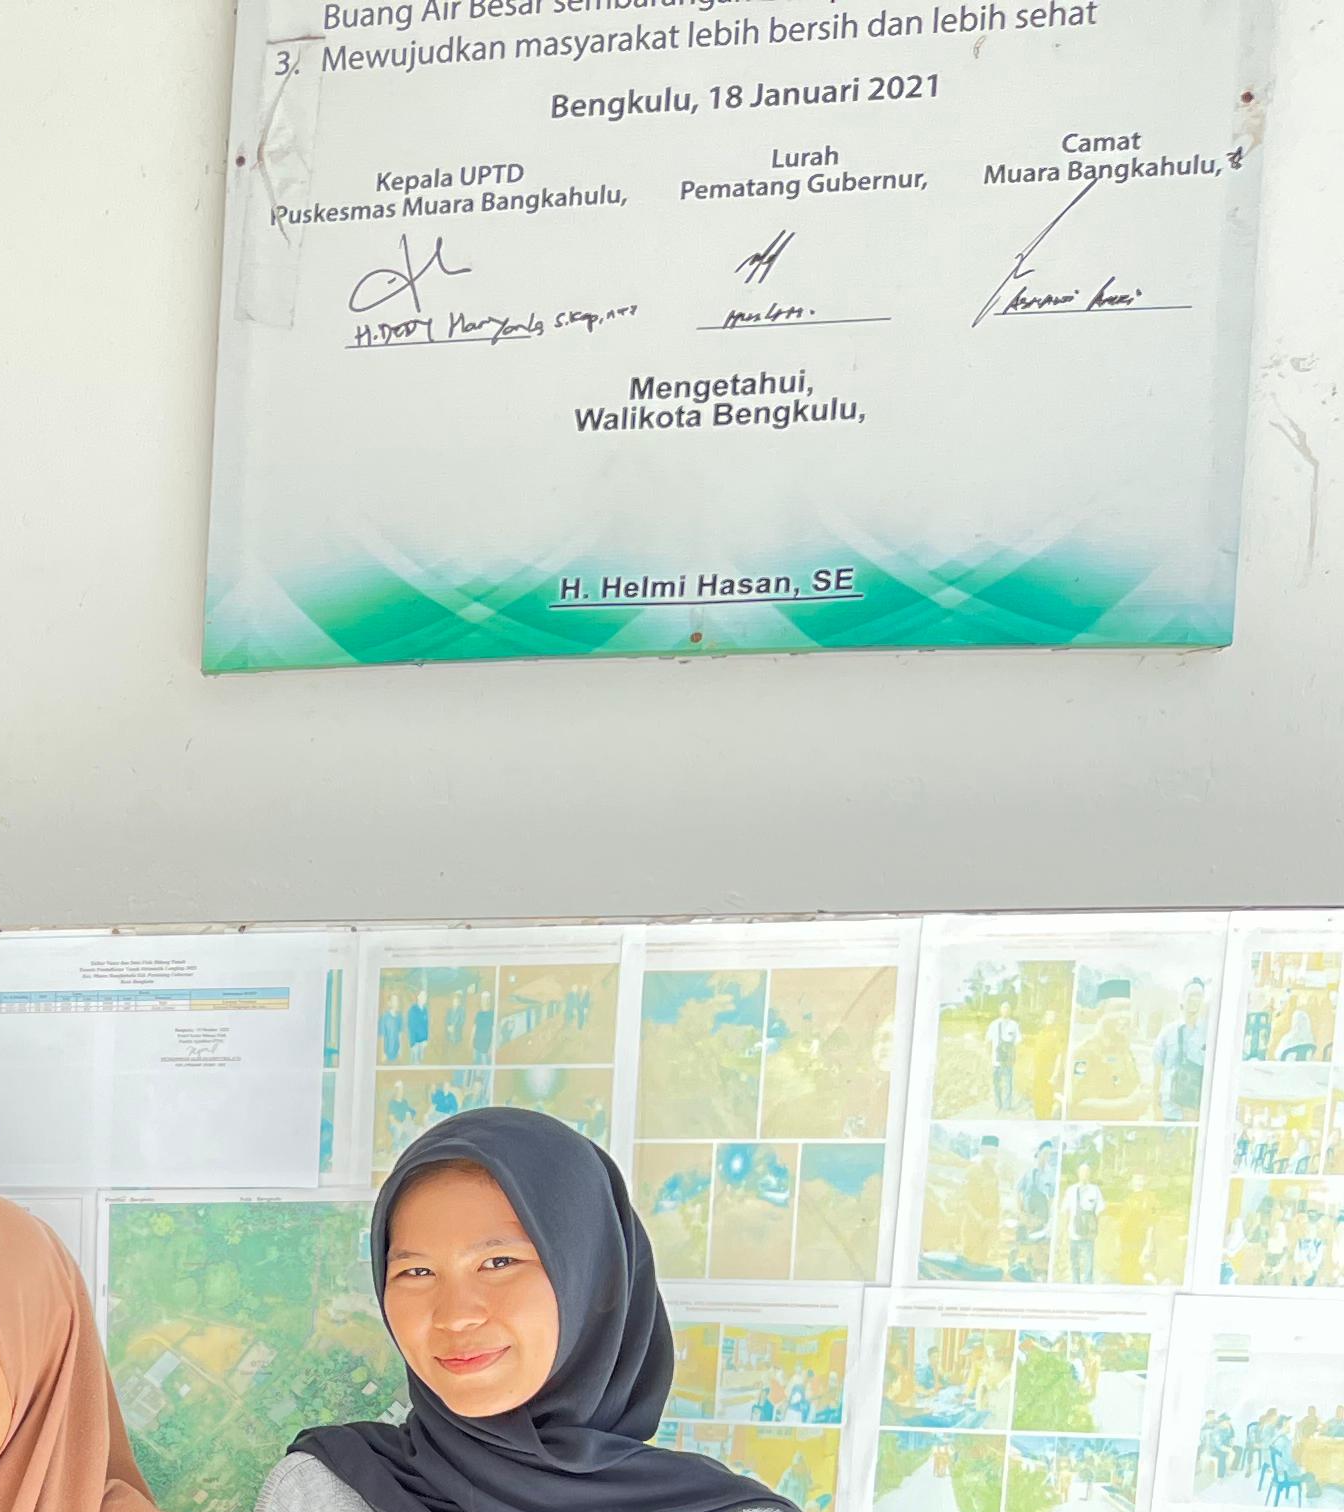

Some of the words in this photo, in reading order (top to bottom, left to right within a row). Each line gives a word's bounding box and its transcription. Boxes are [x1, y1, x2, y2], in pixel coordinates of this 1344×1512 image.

[324, 2, 412, 31] Buang
[421, 0, 461, 22] Air
[470, 0, 543, 19] Besar
[275, 51, 301, 76] 3.
[322, 36, 506, 73] Mewujudkan
[515, 24, 680, 62] masyarakat
[689, 19, 760, 49] lebih
[769, 12, 859, 45] bersih
[867, 7, 925, 38] dan
[931, 3, 1007, 35] lebih
[1015, 0, 1098, 29] sehat
[551, 86, 700, 121] Bengkulu,
[710, 84, 743, 111] 18
[749, 78, 860, 110] Januari
[867, 72, 942, 101] 2021
[771, 145, 839, 170] Lurah
[1061, 130, 1142, 155] Camat
[376, 167, 453, 195] Kepala
[460, 163, 525, 187] UPTD
[680, 174, 801, 203] Pematang
[807, 167, 928, 196] Gubernur,
[983, 160, 1061, 187] Muara
[1066, 153, 1223, 185] Bangkahulu,
[271, 200, 396, 227] Puskesmas
[402, 197, 474, 217] Muara
[480, 184, 628, 216] Bangkahulu,
[629, 369, 813, 403] Mengetahui,
[575, 405, 702, 432] Walikota
[712, 397, 865, 429] Bengkulu,
[560, 577, 589, 600] H.
[602, 574, 686, 599] Helmi
[698, 572, 800, 600] Hasan,
[812, 567, 855, 592] SE
